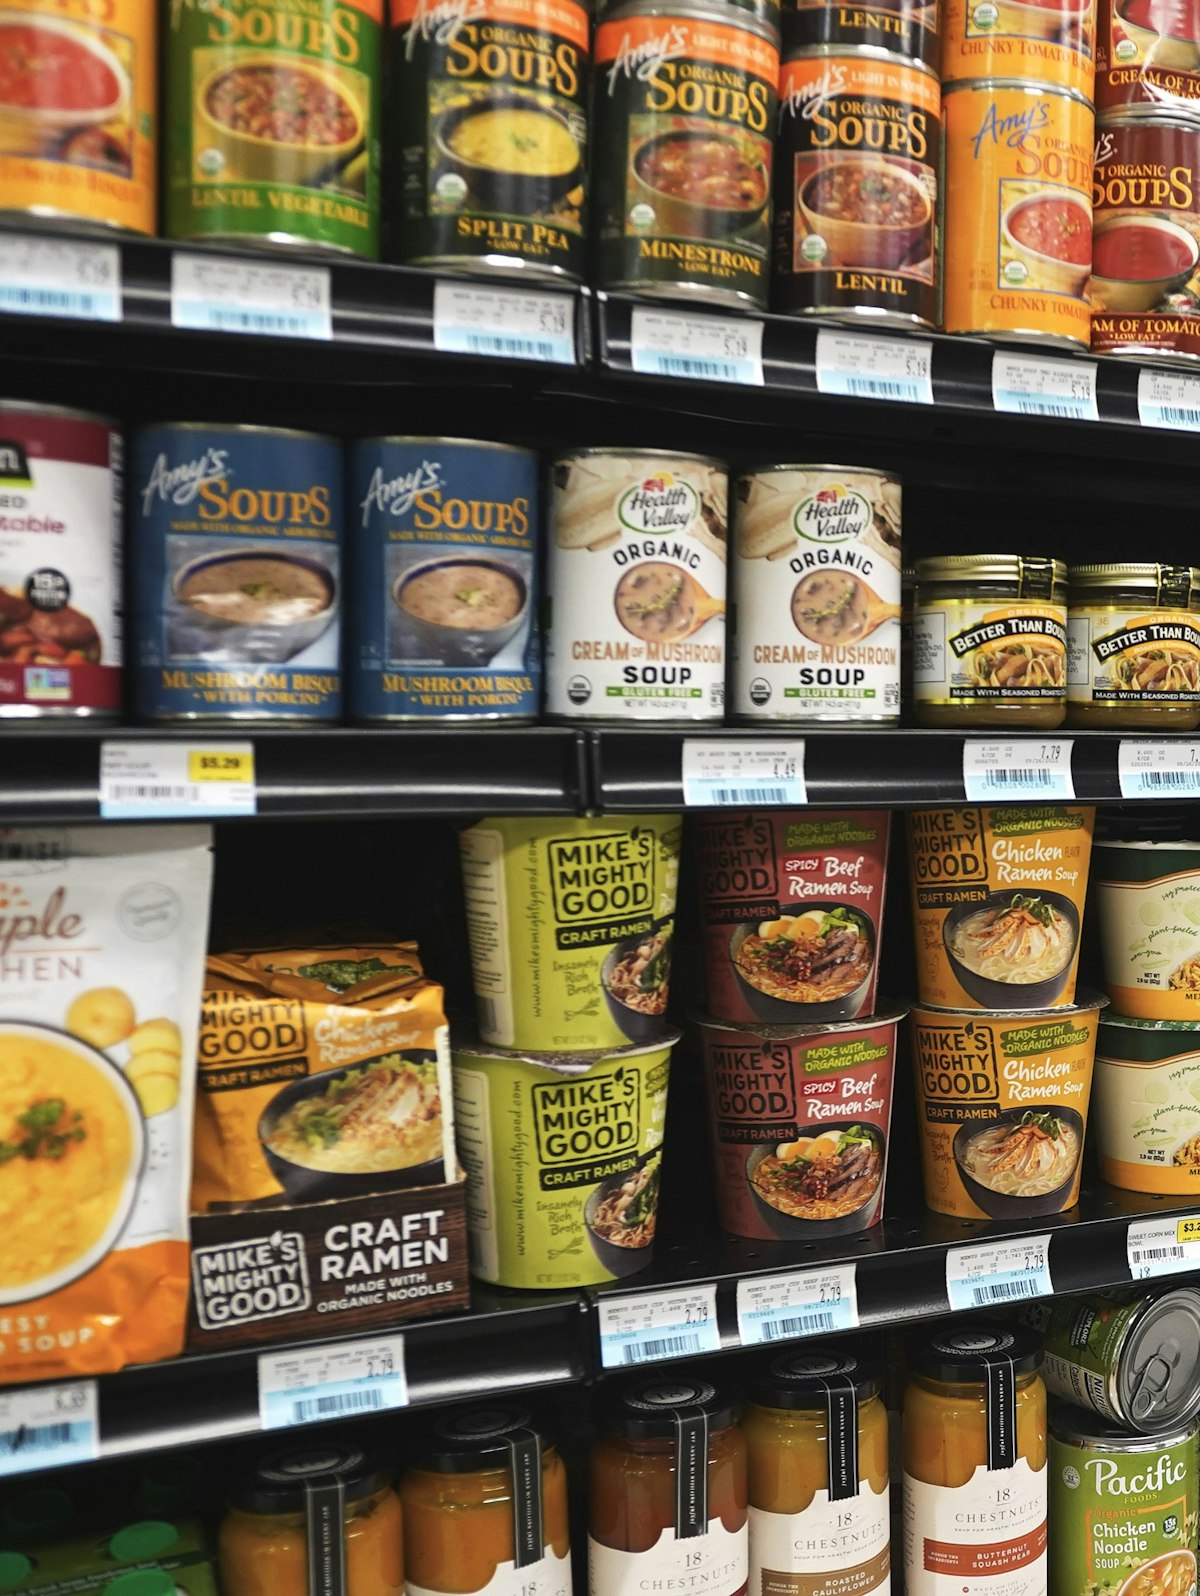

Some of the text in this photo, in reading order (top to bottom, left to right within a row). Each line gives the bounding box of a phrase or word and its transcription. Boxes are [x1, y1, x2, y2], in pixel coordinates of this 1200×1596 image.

[608, 25, 690, 97] Amy's
[840, 101, 906, 124] ORGANIC
[810, 103, 928, 160] SOUPS
[970, 101, 1054, 159] Amy's
[1106, 163, 1168, 179] ORGANIC
[457, 217, 571, 251] SPLIT PEA
[639, 239, 762, 276] MINESTRONE
[836, 272, 908, 296] LENTIL
[1118, 318, 1144, 333] OF
[905, 358, 927, 377] 5.19
[360, 460, 445, 527] Amy's
[415, 489, 530, 536] SOUPS
[805, 497, 860, 521] Health
[816, 517, 863, 537] Valley
[789, 549, 873, 576] ORGANIC
[1097, 626, 1178, 659] BETTER THAN
[754, 645, 897, 665] CREAM OF MUSHROOM
[383, 674, 491, 693] MUSHROOM
[800, 668, 865, 685] SOUP
[800, 688, 840, 698] GLUTEN
[1096, 692, 1177, 701] MADE WITH SEASONED
[1041, 745, 1061, 760] 7.79
[920, 1021, 989, 1052] MIKE'S
[922, 1052, 988, 1072] MIGHTY
[1003, 1058, 1071, 1082] Chicken
[803, 1072, 877, 1098] SPICY Beef
[925, 1071, 992, 1096] GOOD
[1008, 1081, 1084, 1102] Ramen Soup
[806, 1097, 885, 1120] Ramen Soup
[323, 1210, 445, 1252] CRAFT
[1128, 1230, 1176, 1242] SWEET CORN MEX
[200, 1231, 298, 1276] MIKE'S
[320, 1238, 449, 1281] RAMEN
[1024, 1253, 1044, 1271] 2.79
[202, 1263, 299, 1297] MIGHTY
[344, 1271, 428, 1295] MADE WITH
[206, 1284, 301, 1321] GOOD
[316, 1280, 454, 1314] ORGANIC NOODLES
[1084, 1454, 1188, 1496] Pacific
[954, 1498, 1040, 1524] CHESTNUTS
[1095, 1507, 1138, 1520] Organic
[1093, 1520, 1157, 1539] Chicken
[976, 1542, 1029, 1560] BUTTERNUT
[1094, 1536, 1148, 1554] Noodle
[971, 1550, 1032, 1569] SQUASH PEAR
[1095, 1556, 1120, 1569] SOUP
[812, 1574, 876, 1596] CAULIFLOWER
[825, 1570, 867, 1587] ROASTED
